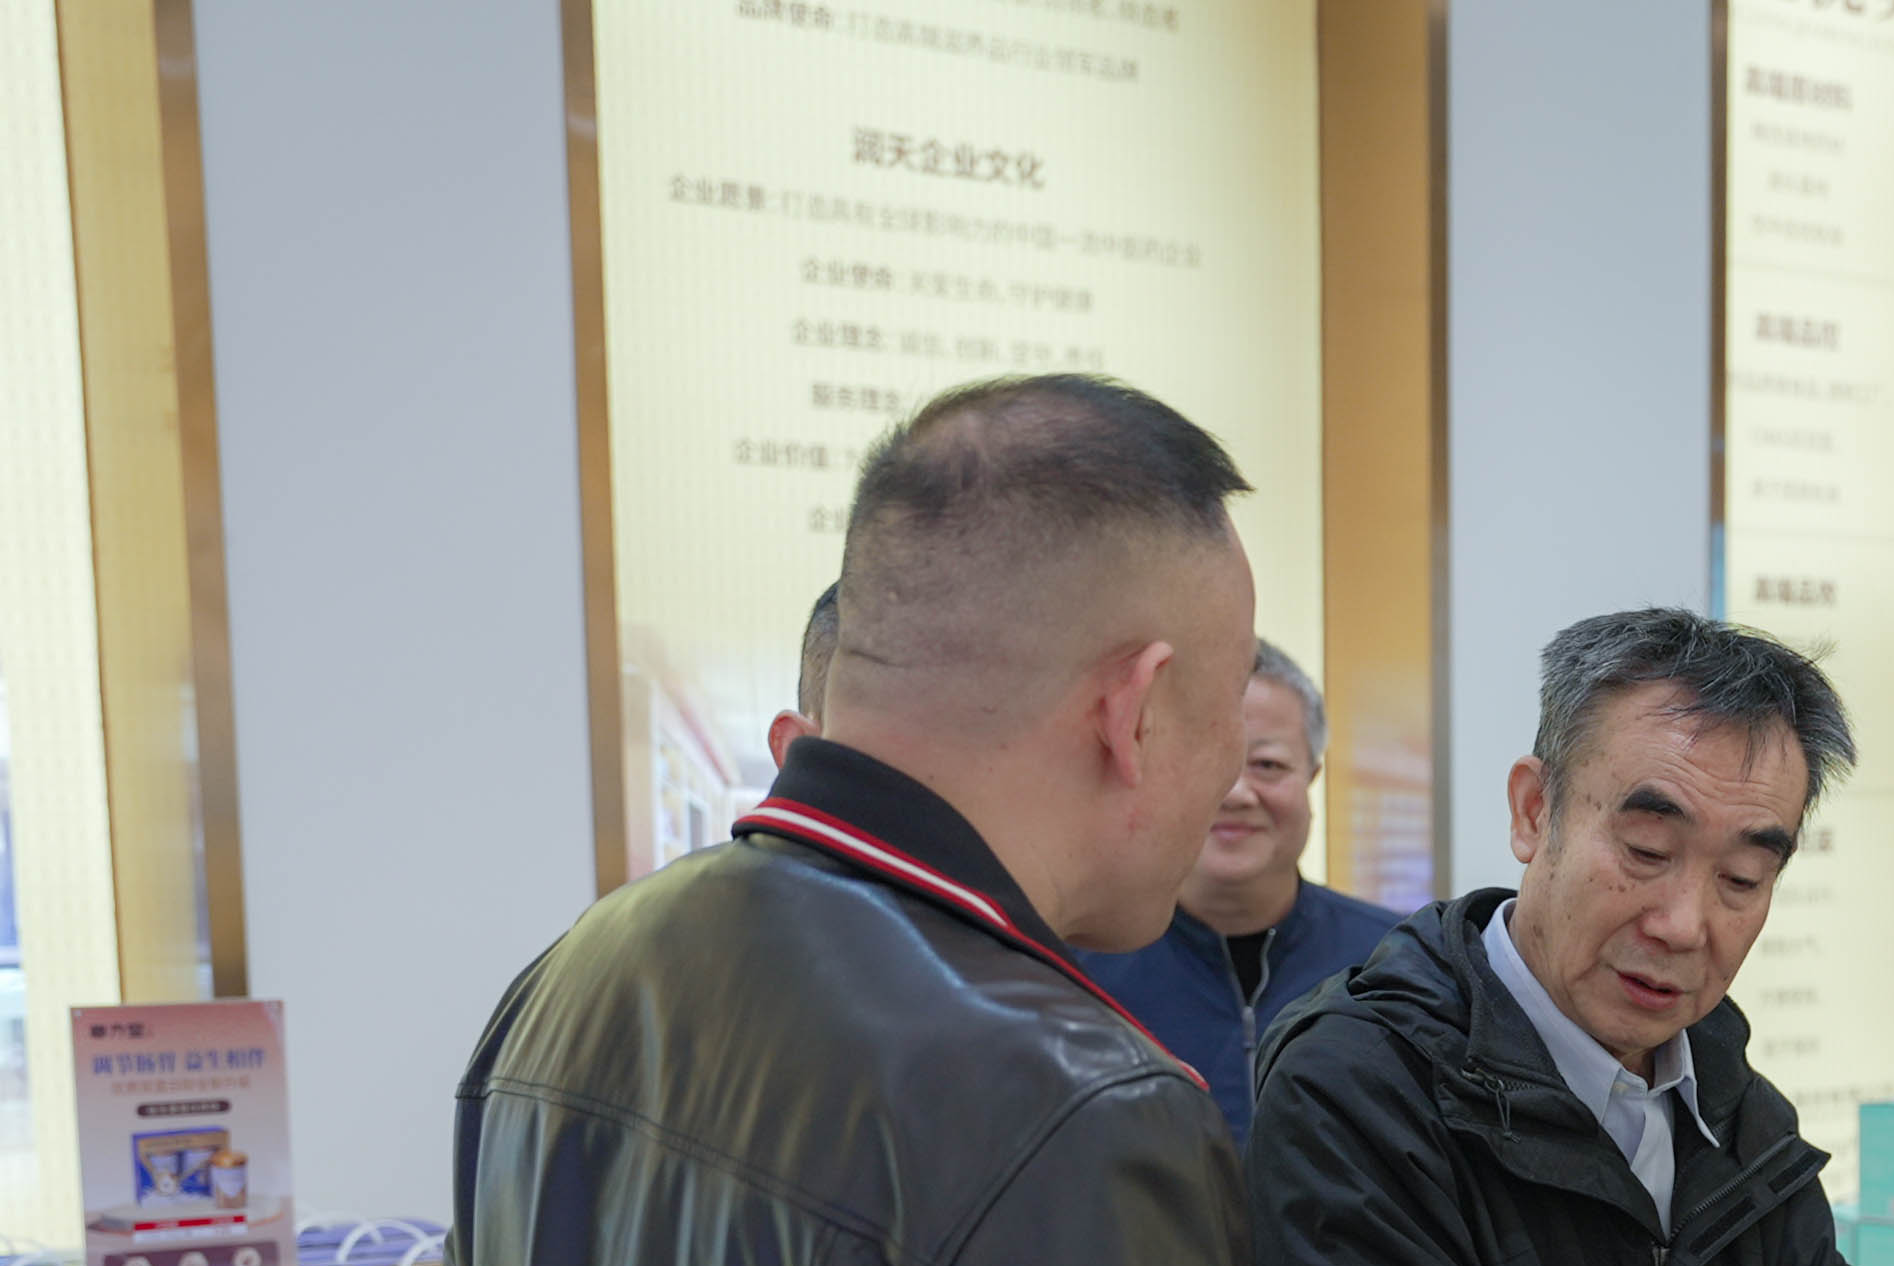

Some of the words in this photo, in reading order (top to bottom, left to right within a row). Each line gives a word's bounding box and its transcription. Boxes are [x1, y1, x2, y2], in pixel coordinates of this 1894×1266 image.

[852, 125, 1046, 189] 润天企业文化
